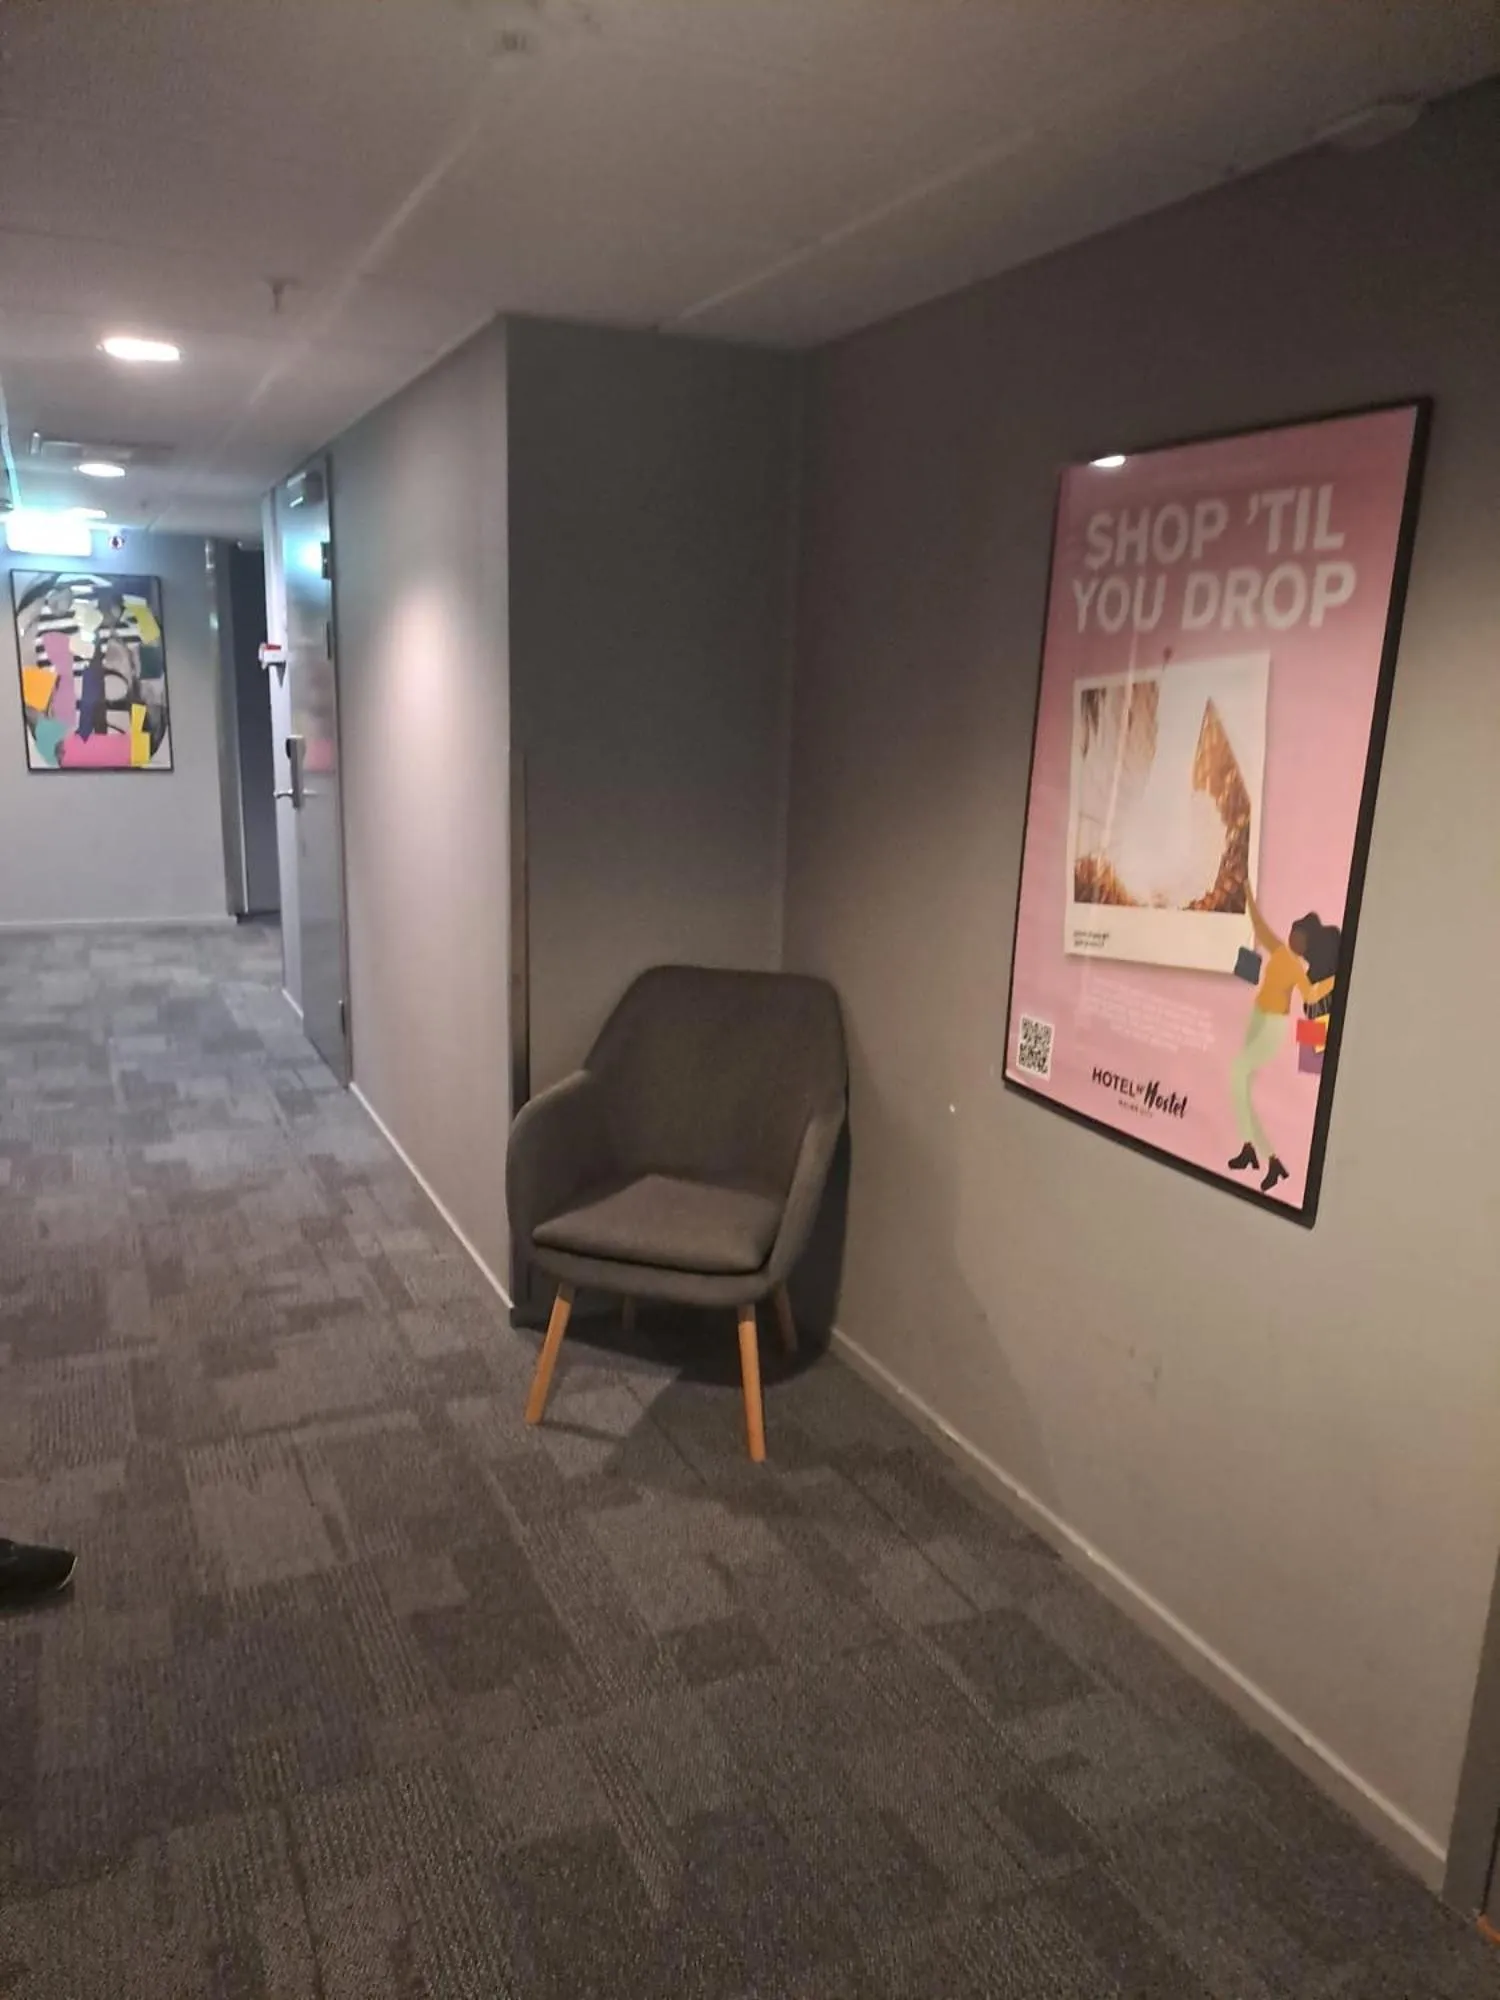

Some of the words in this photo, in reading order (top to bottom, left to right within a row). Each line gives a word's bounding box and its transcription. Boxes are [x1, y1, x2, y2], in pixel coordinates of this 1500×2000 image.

[1084, 499, 1229, 570] SHOP
[1071, 573, 1167, 634] YOU
[1180, 561, 1357, 631] DROP
[1092, 1066, 1135, 1098] HOTEL
